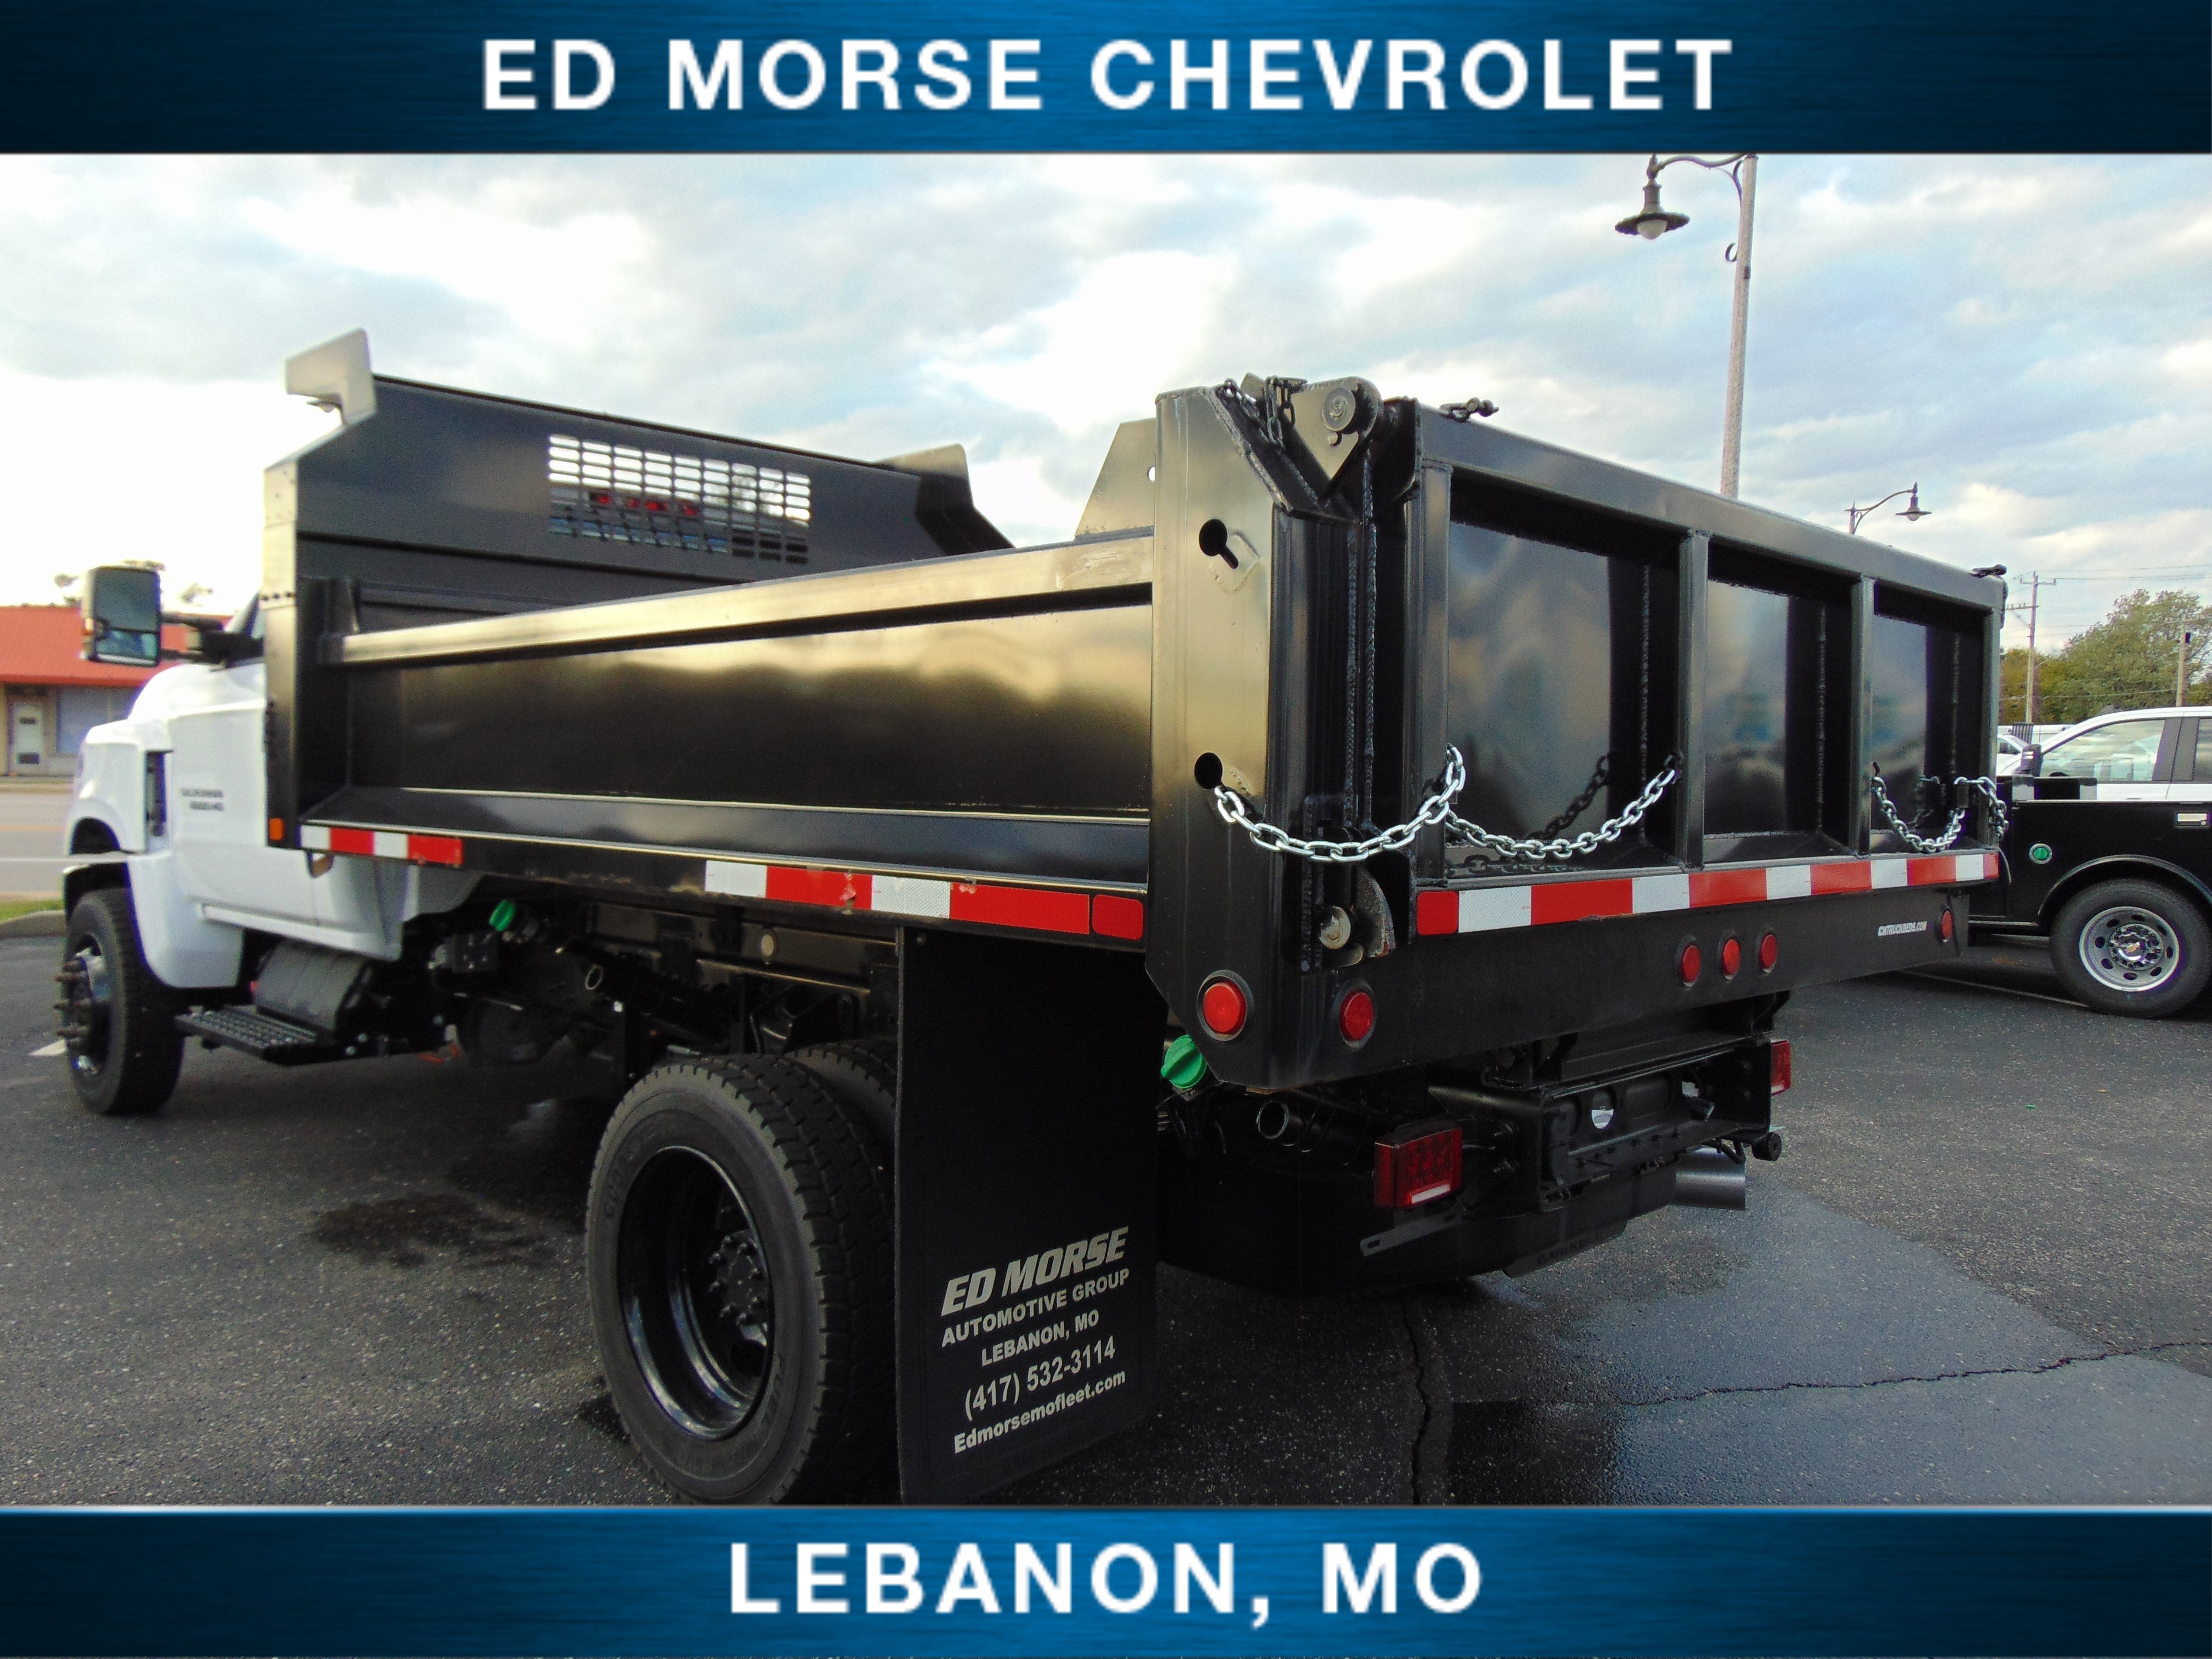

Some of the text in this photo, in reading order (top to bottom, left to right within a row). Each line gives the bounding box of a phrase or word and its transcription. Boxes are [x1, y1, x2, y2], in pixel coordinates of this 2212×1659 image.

[941, 1228, 1128, 1316] ED MORSE
[942, 1269, 1129, 1347] AUTOMOTIVE GROUP
[966, 1336, 1115, 1421] (417) 532-3114
[982, 1310, 1099, 1366] LEBANON, MO
[954, 1371, 1125, 1453] Edmorsemofleet.com
